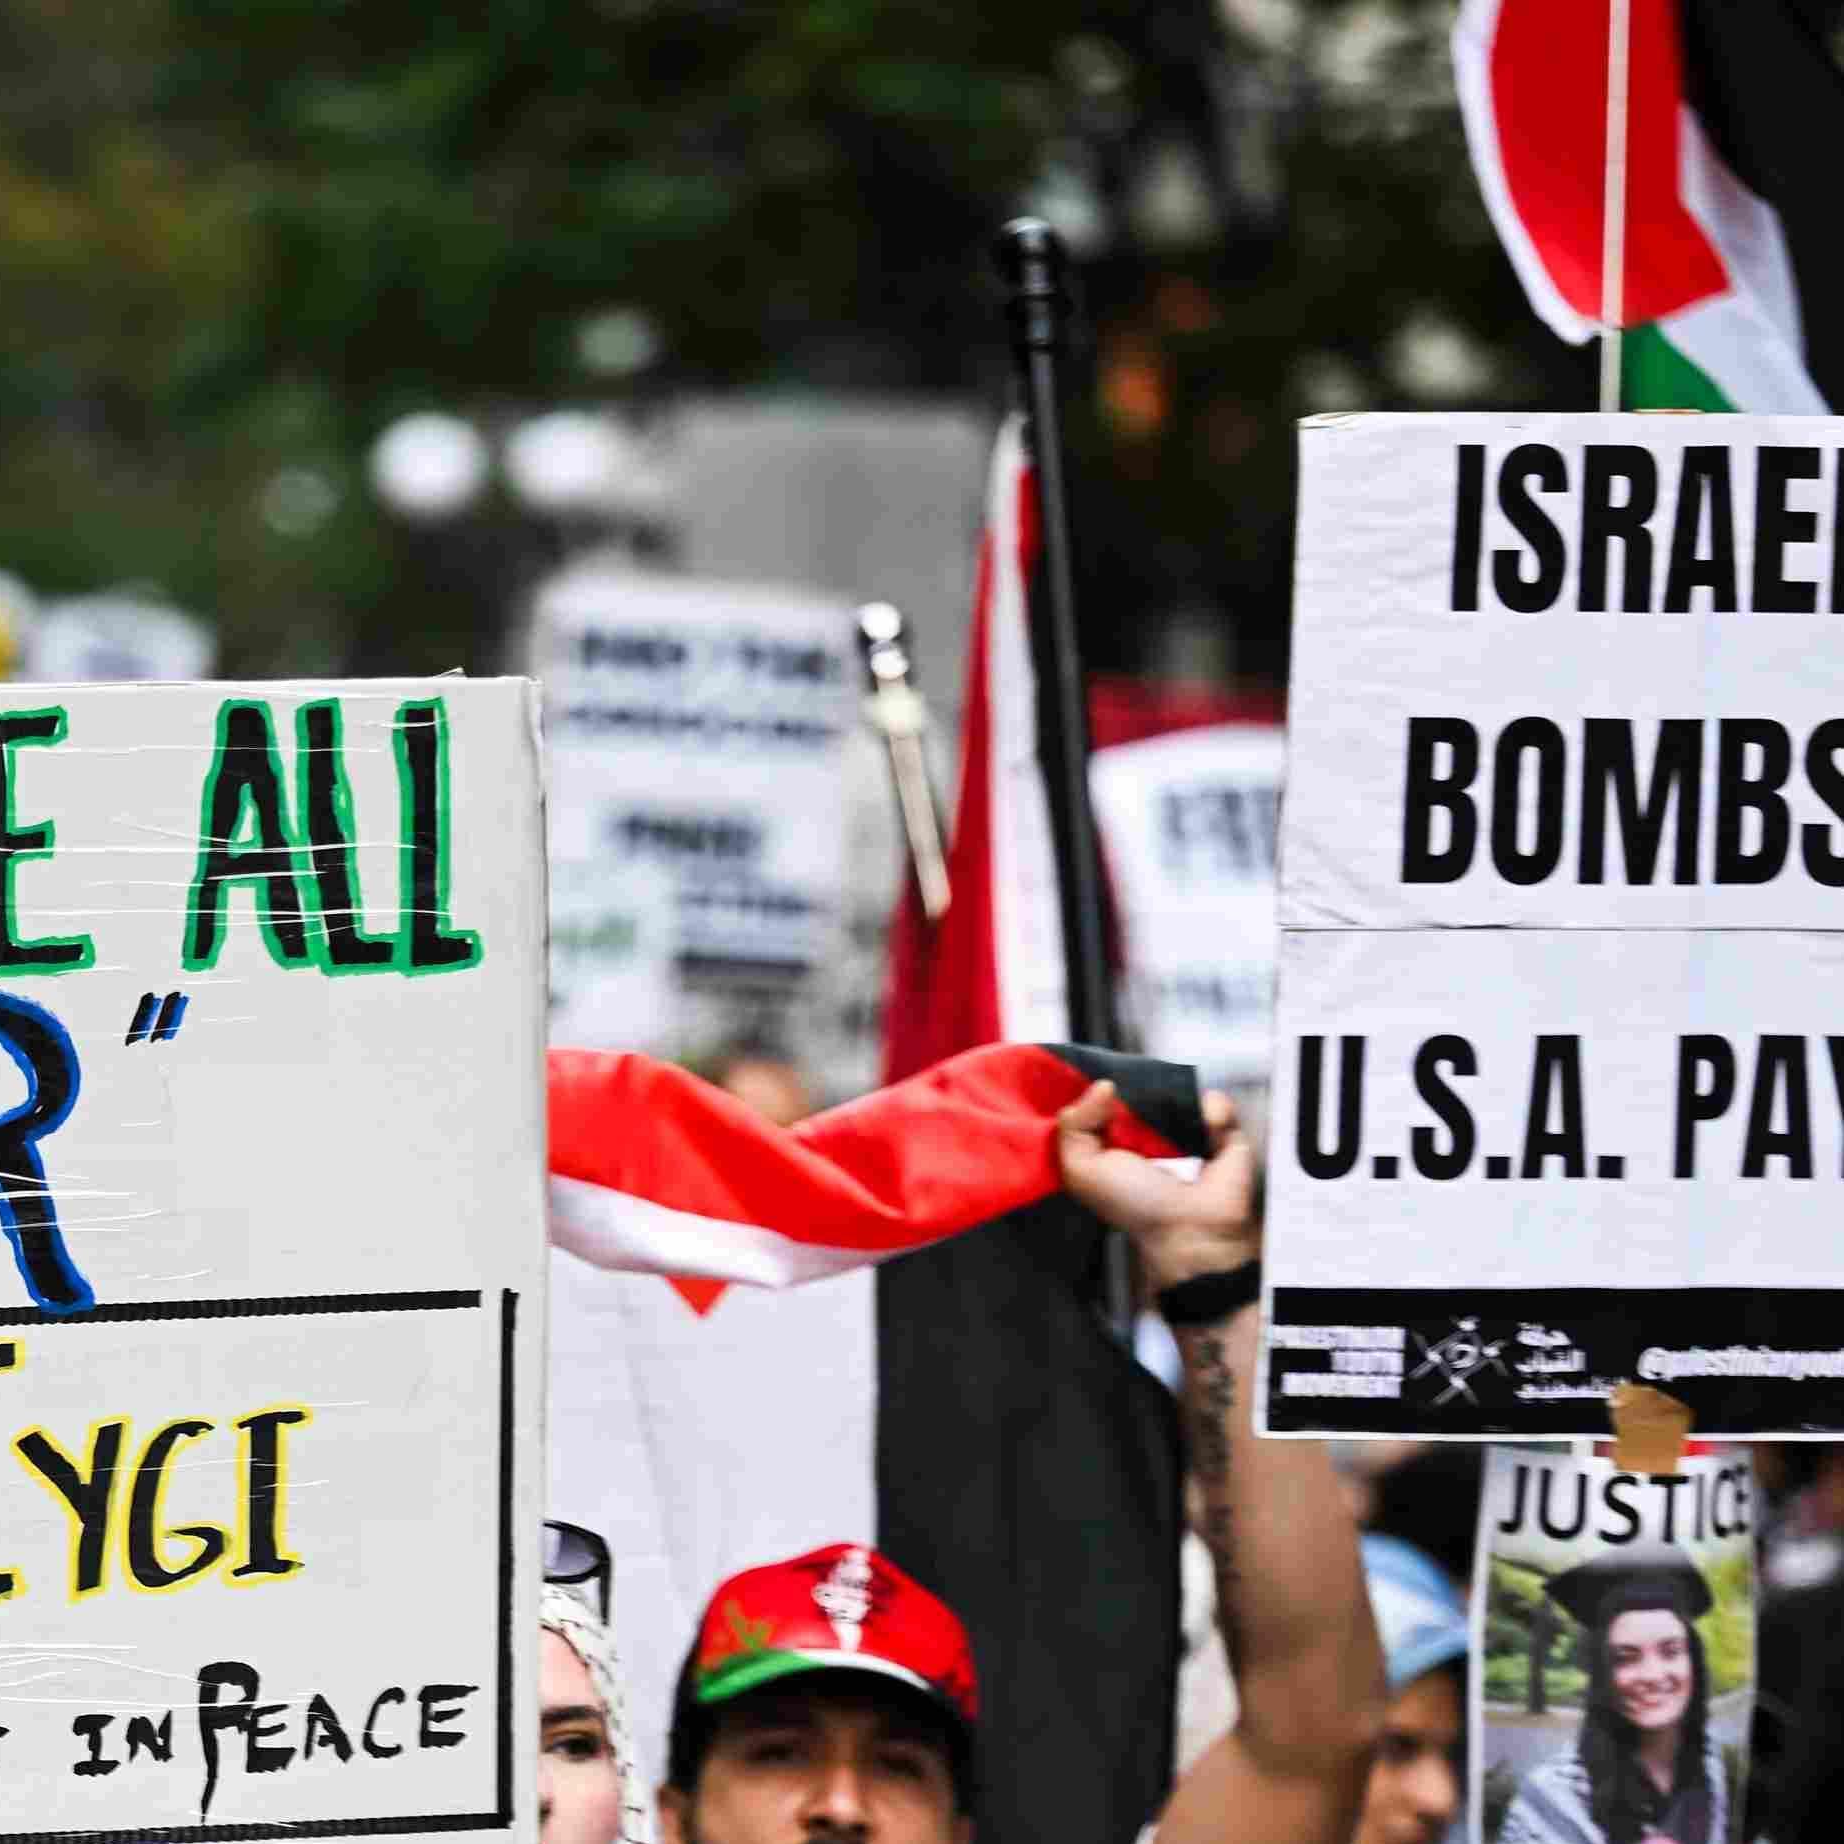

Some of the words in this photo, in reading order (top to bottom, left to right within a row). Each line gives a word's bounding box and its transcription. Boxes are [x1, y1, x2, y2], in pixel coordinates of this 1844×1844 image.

[1449, 443, 1844, 614] ISRAE
[182, 696, 483, 977] ALL
[1294, 1034, 1625, 1180] U.S.A.
